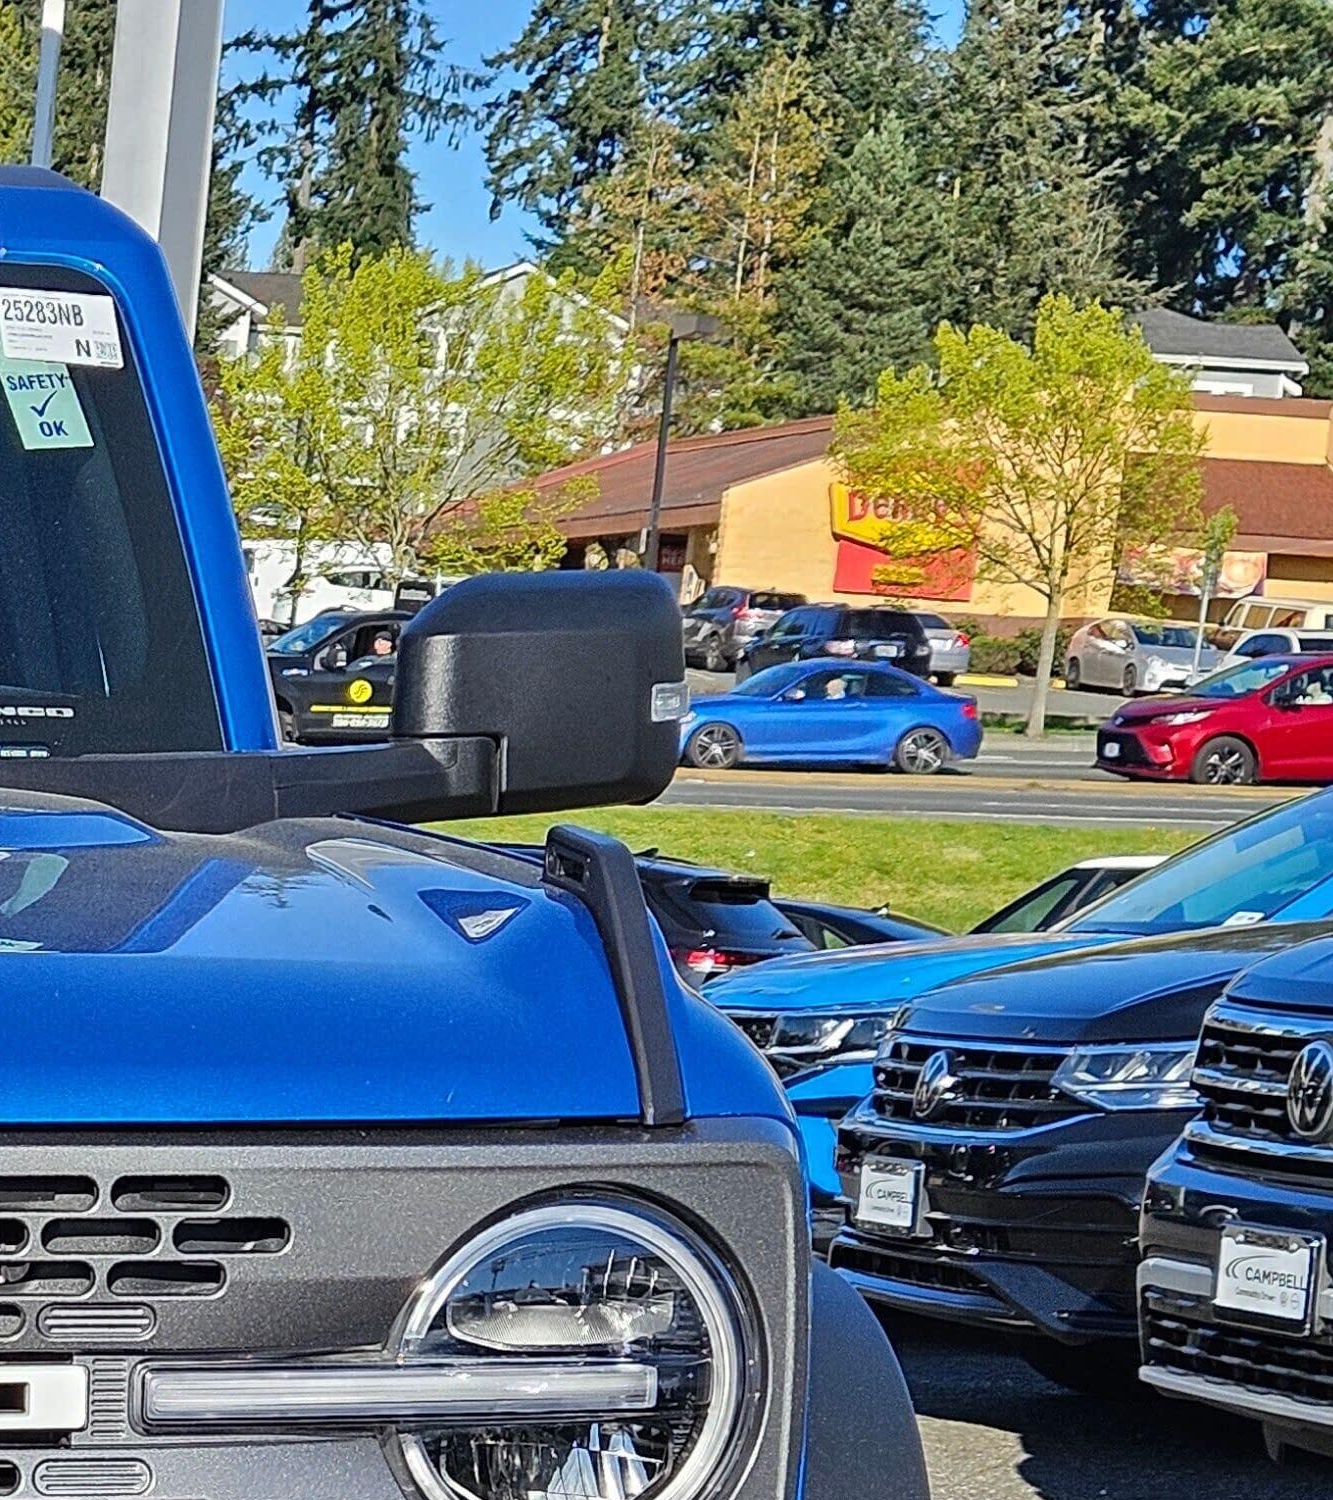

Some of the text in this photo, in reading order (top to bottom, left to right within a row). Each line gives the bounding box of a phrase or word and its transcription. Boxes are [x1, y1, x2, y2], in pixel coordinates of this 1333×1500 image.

[1, 298, 84, 327] 25283NB
[75, 338, 92, 358] N
[6, 373, 66, 391] SAFETY
[38, 420, 69, 437] OK
[1245, 1266, 1305, 1290] CAMPBELL
